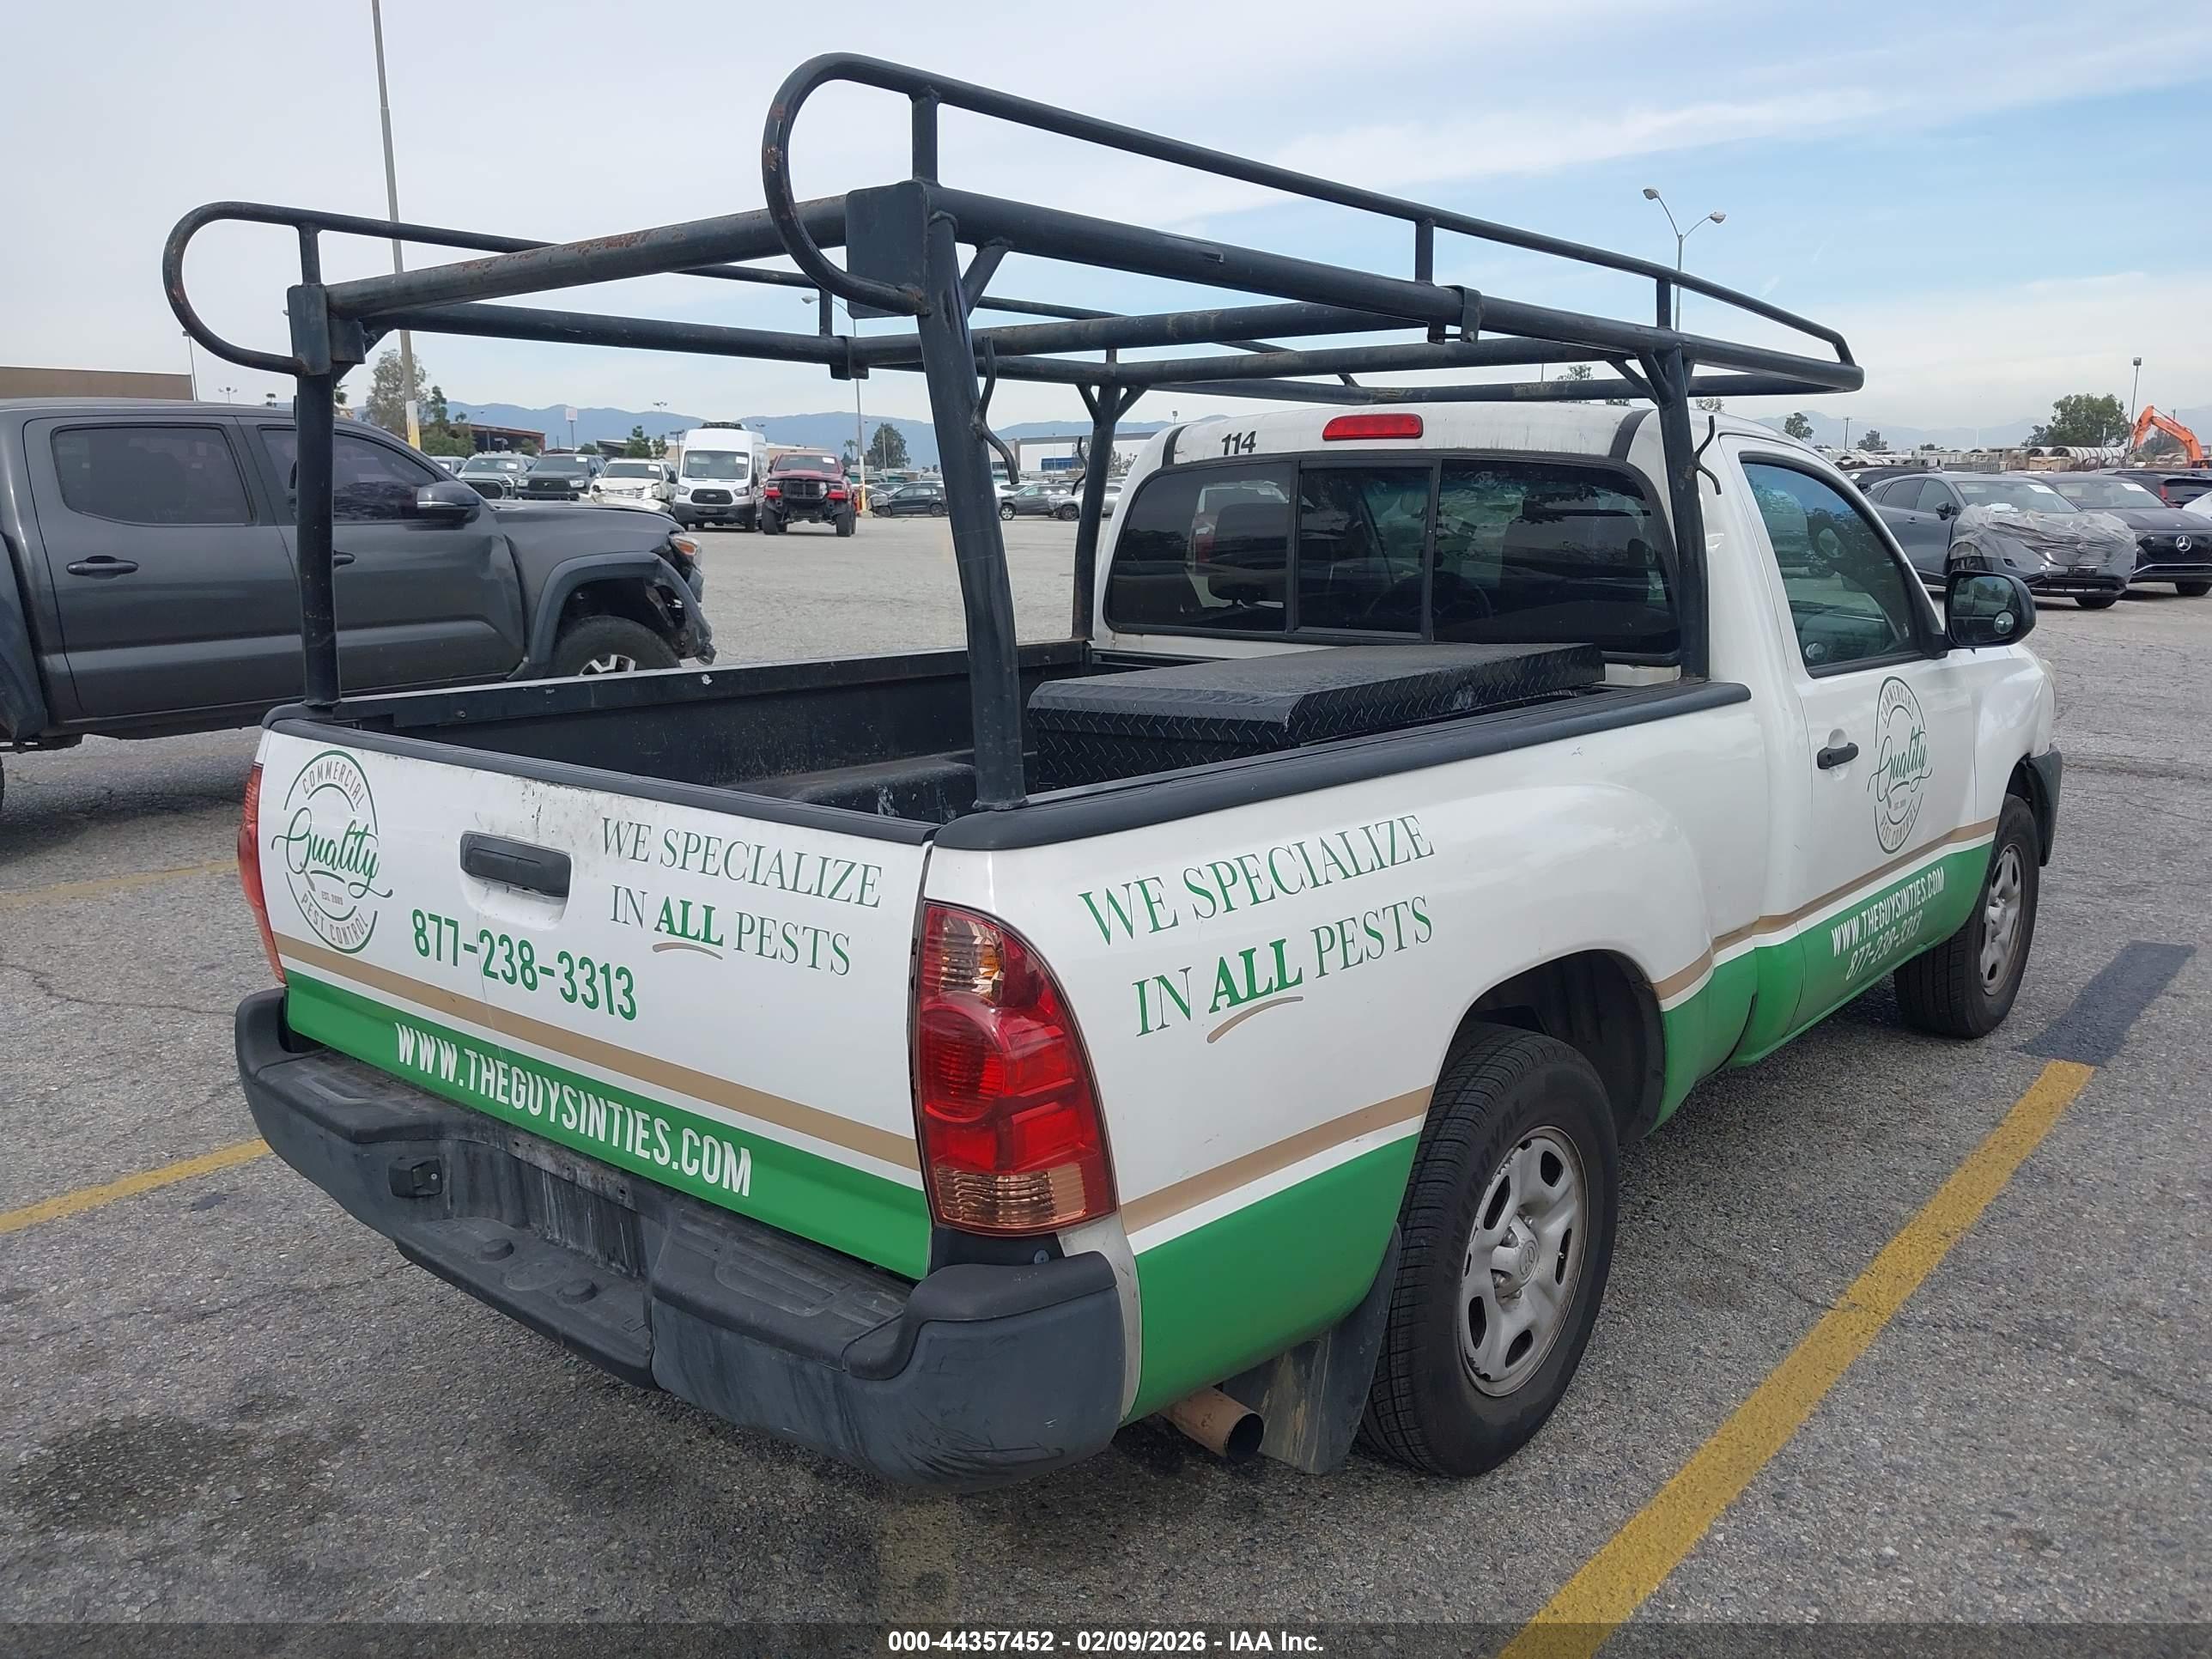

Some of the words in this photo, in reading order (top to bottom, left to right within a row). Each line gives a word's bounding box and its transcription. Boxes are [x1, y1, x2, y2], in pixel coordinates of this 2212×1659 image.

[1221, 430, 1257, 455] 114
[1881, 685, 1914, 724] COMMERCIAL
[302, 761, 365, 809] COMMERCIAL
[1867, 724, 1932, 802] Quality
[271, 806, 393, 899] Quality
[602, 817, 652, 864] WE
[659, 828, 883, 908] SPECIALIZE
[1880, 815, 1891, 846] PEST
[1891, 803, 1917, 847] CONTROL
[301, 892, 325, 932] PEST
[330, 912, 368, 945] CONTROL
[1079, 875, 1179, 946] WE
[1182, 814, 1435, 920] SPECIALIZE
[1831, 866, 1945, 957] WWW.THEGUYSINTIES.COM
[412, 908, 637, 1021] 877-238-3313
[611, 884, 648, 929] IN
[653, 896, 724, 947] ALL
[733, 911, 851, 976] PESTS
[1132, 966, 1193, 1037] IN
[1208, 938, 1304, 1014] ALL
[1310, 895, 1433, 979] PESTS
[1845, 909, 1923, 981] 877-238-3313
[394, 1022, 752, 1198] WWW.THEGUYSINTIES.COM
